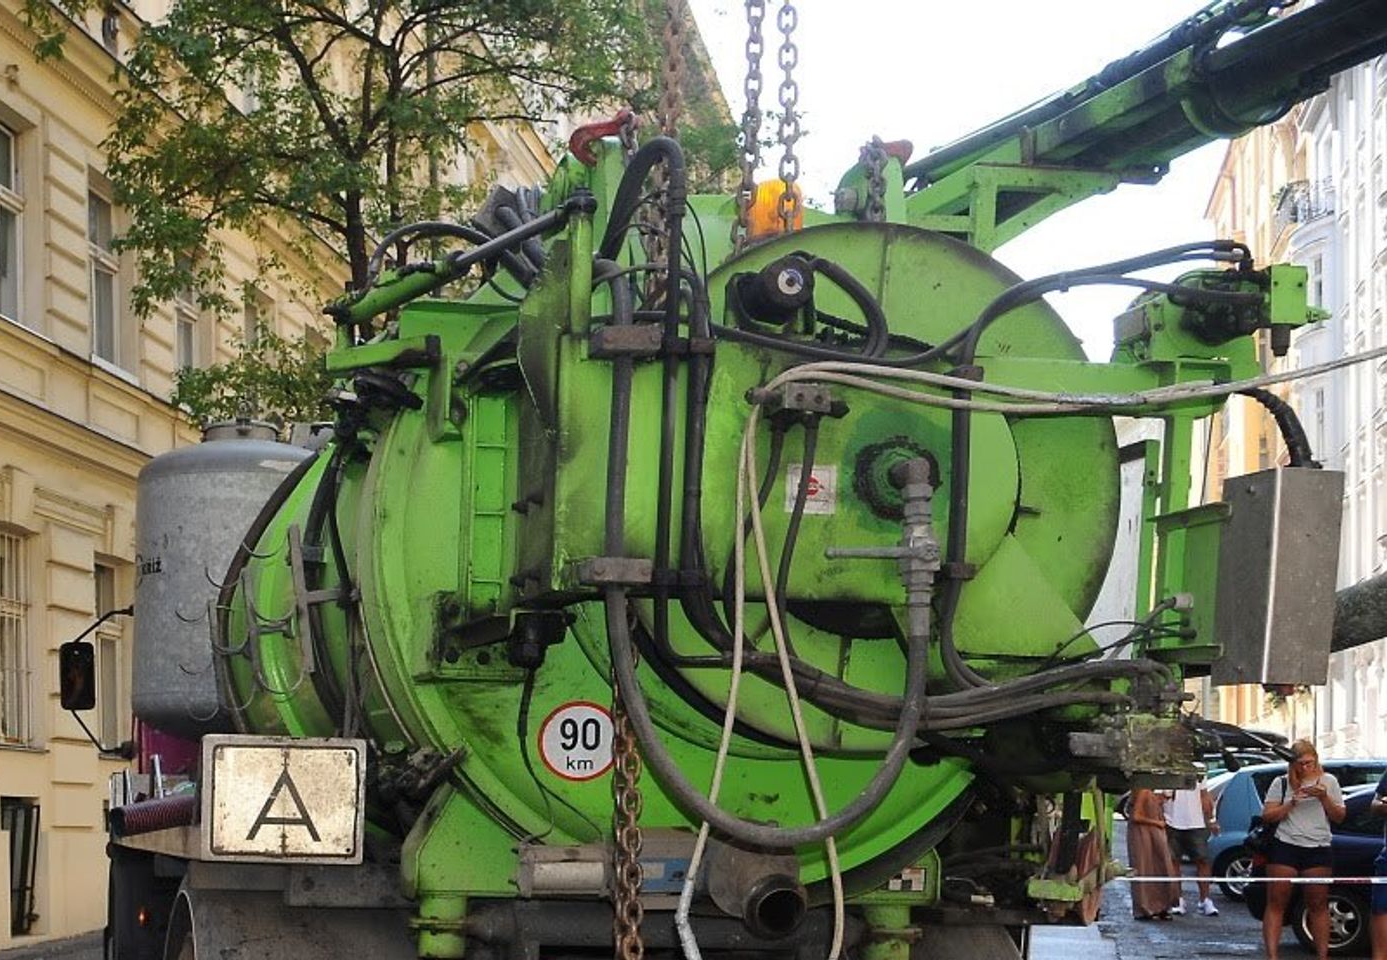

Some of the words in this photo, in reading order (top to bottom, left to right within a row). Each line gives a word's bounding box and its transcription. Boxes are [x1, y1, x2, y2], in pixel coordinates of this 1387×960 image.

[560, 718, 601, 751] 90
[566, 756, 594, 770] km
[246, 768, 321, 842] A
